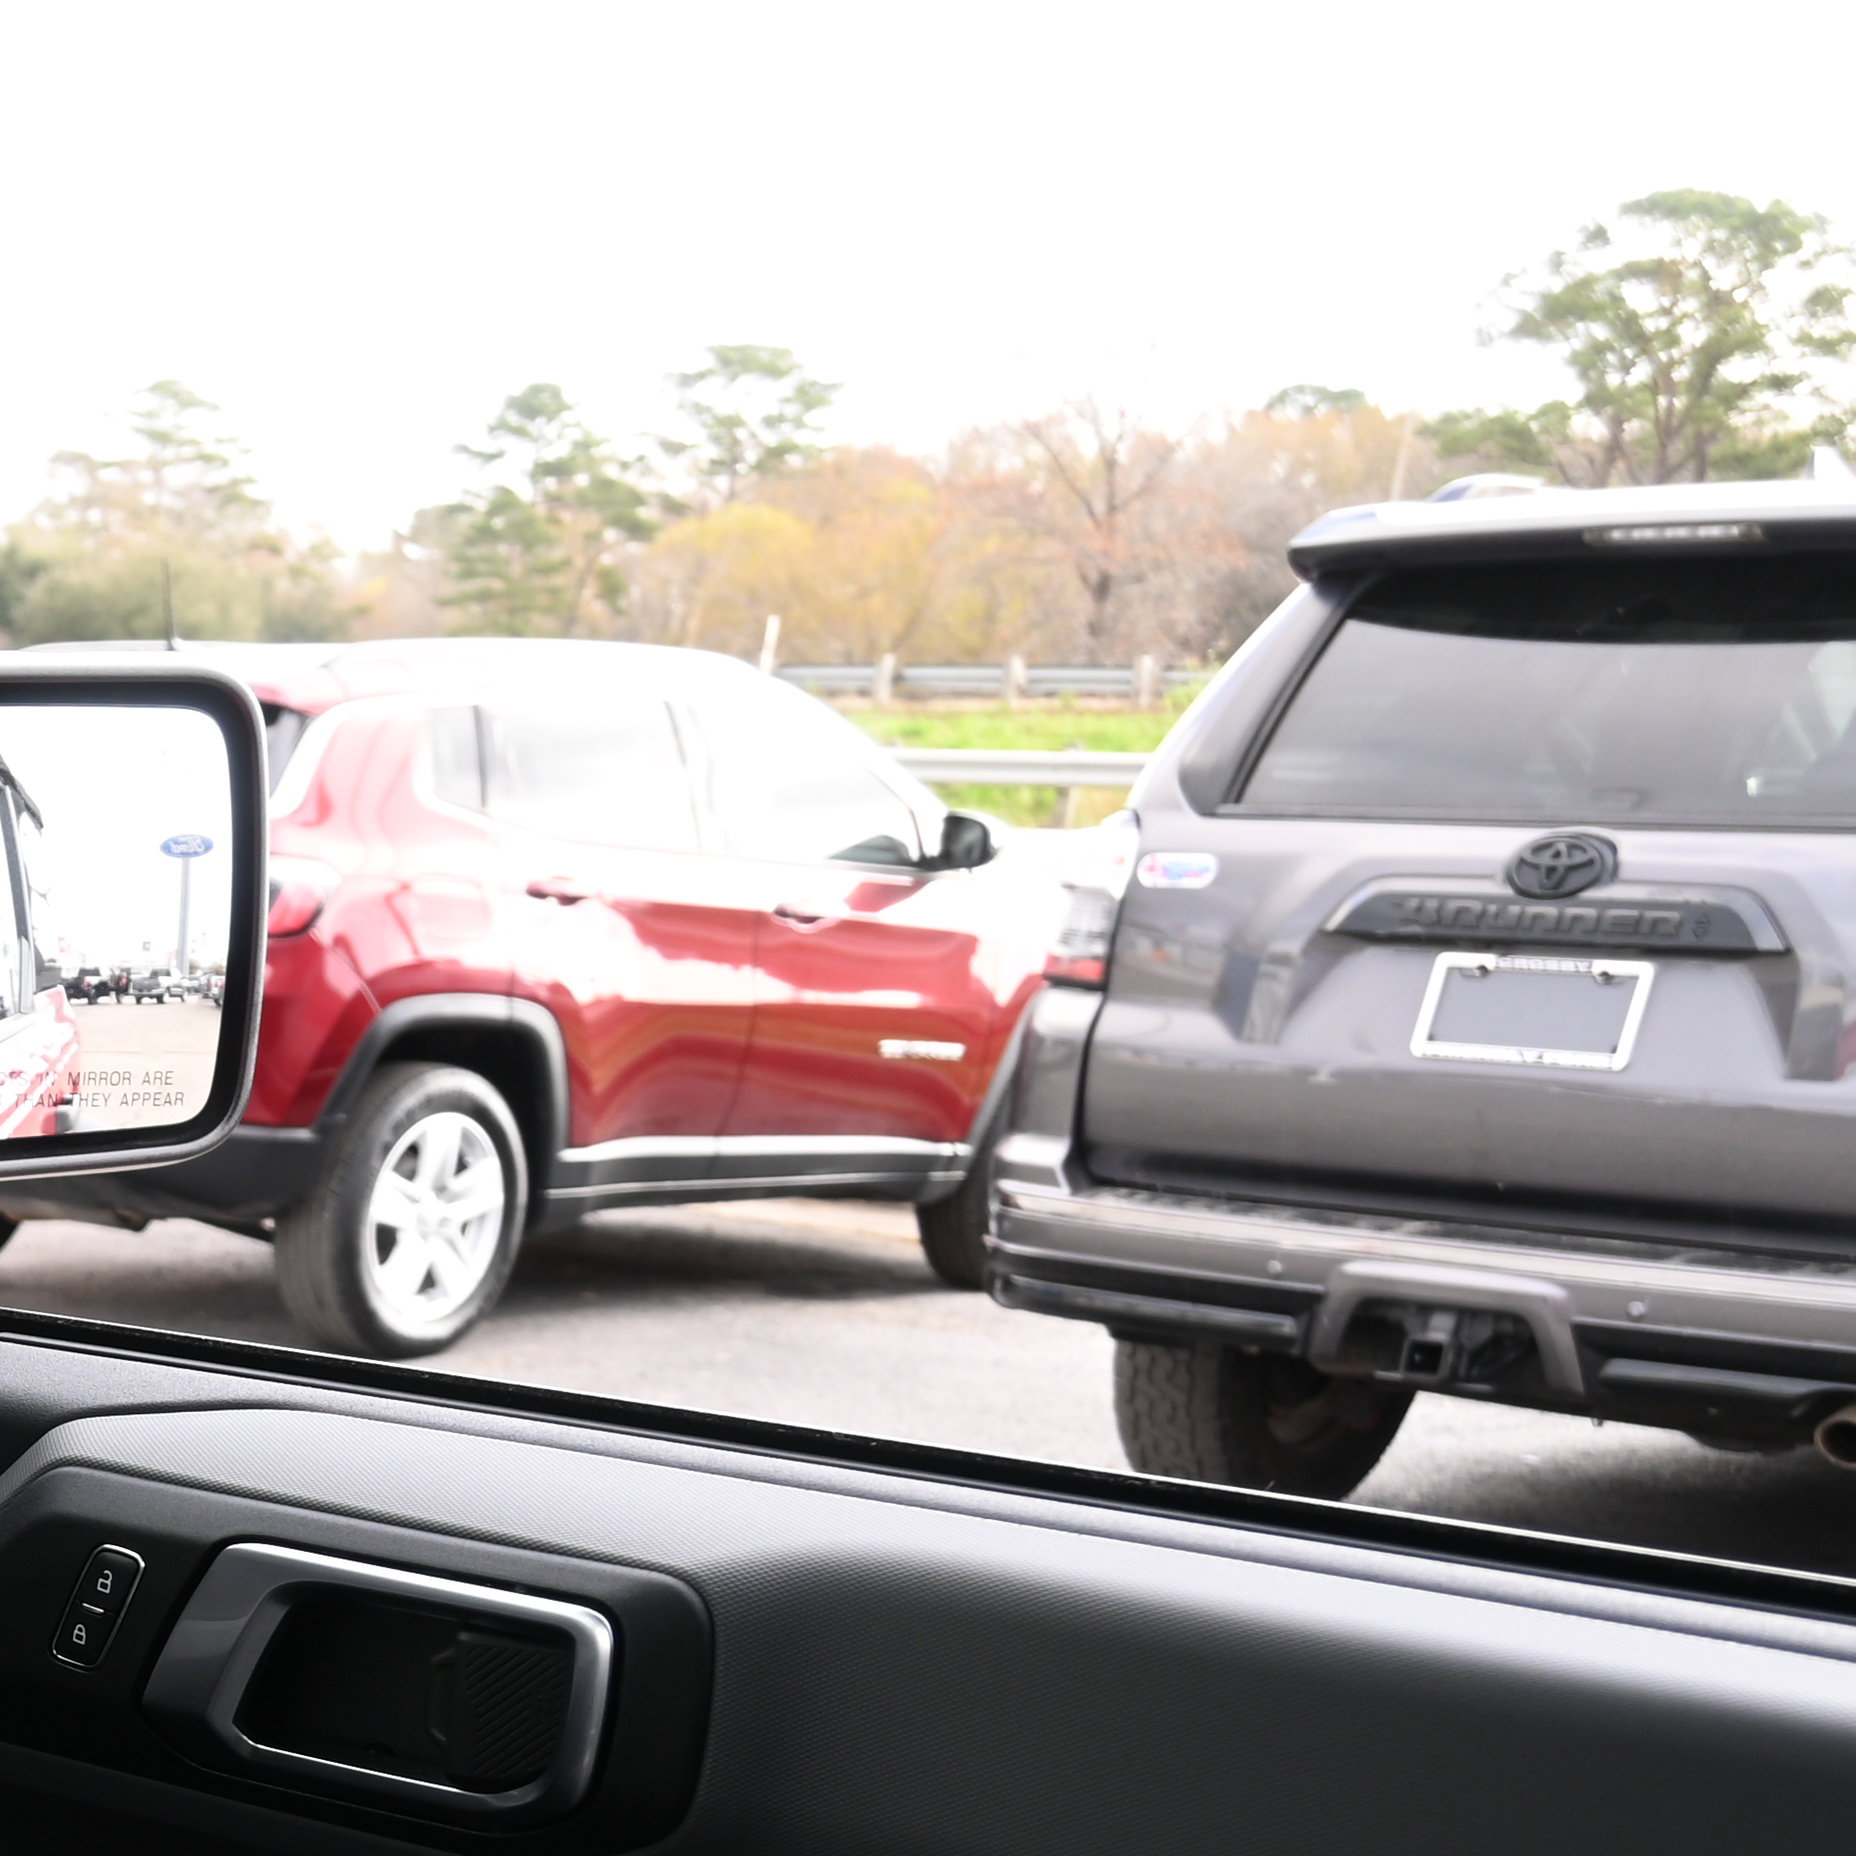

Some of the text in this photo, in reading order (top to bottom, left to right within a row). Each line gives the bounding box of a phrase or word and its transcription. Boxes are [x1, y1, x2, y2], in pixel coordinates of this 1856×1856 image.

[67, 1071, 133, 1087] MIRROR
[141, 1070, 175, 1086] ARE
[15, 1093, 60, 1108] THAN
[69, 1092, 112, 1108] THEY
[119, 1091, 186, 1108] APPEAR
